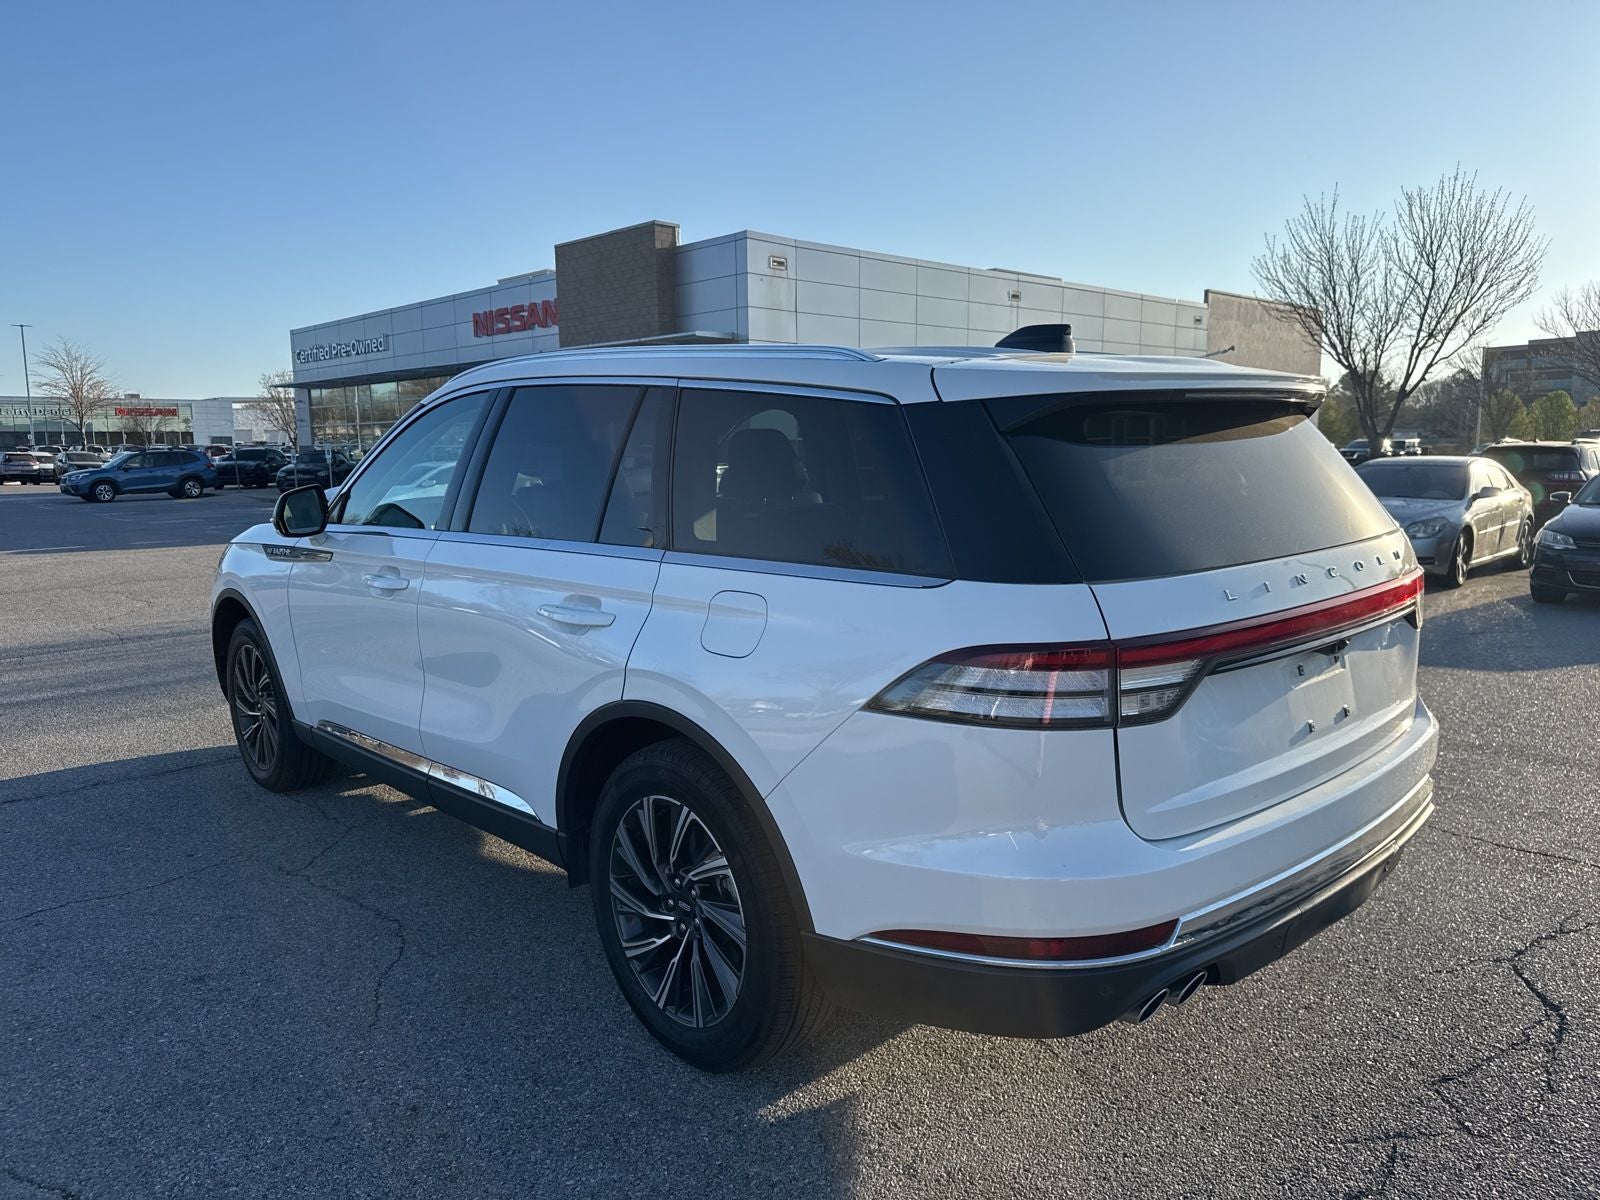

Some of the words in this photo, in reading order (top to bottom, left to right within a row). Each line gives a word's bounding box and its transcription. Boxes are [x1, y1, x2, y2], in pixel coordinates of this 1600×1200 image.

[472, 298, 559, 337] NISSAN
[295, 343, 330, 364] Certified
[331, 334, 385, 358] Pre-Owned
[1223, 550, 1401, 601] LINCOLN
